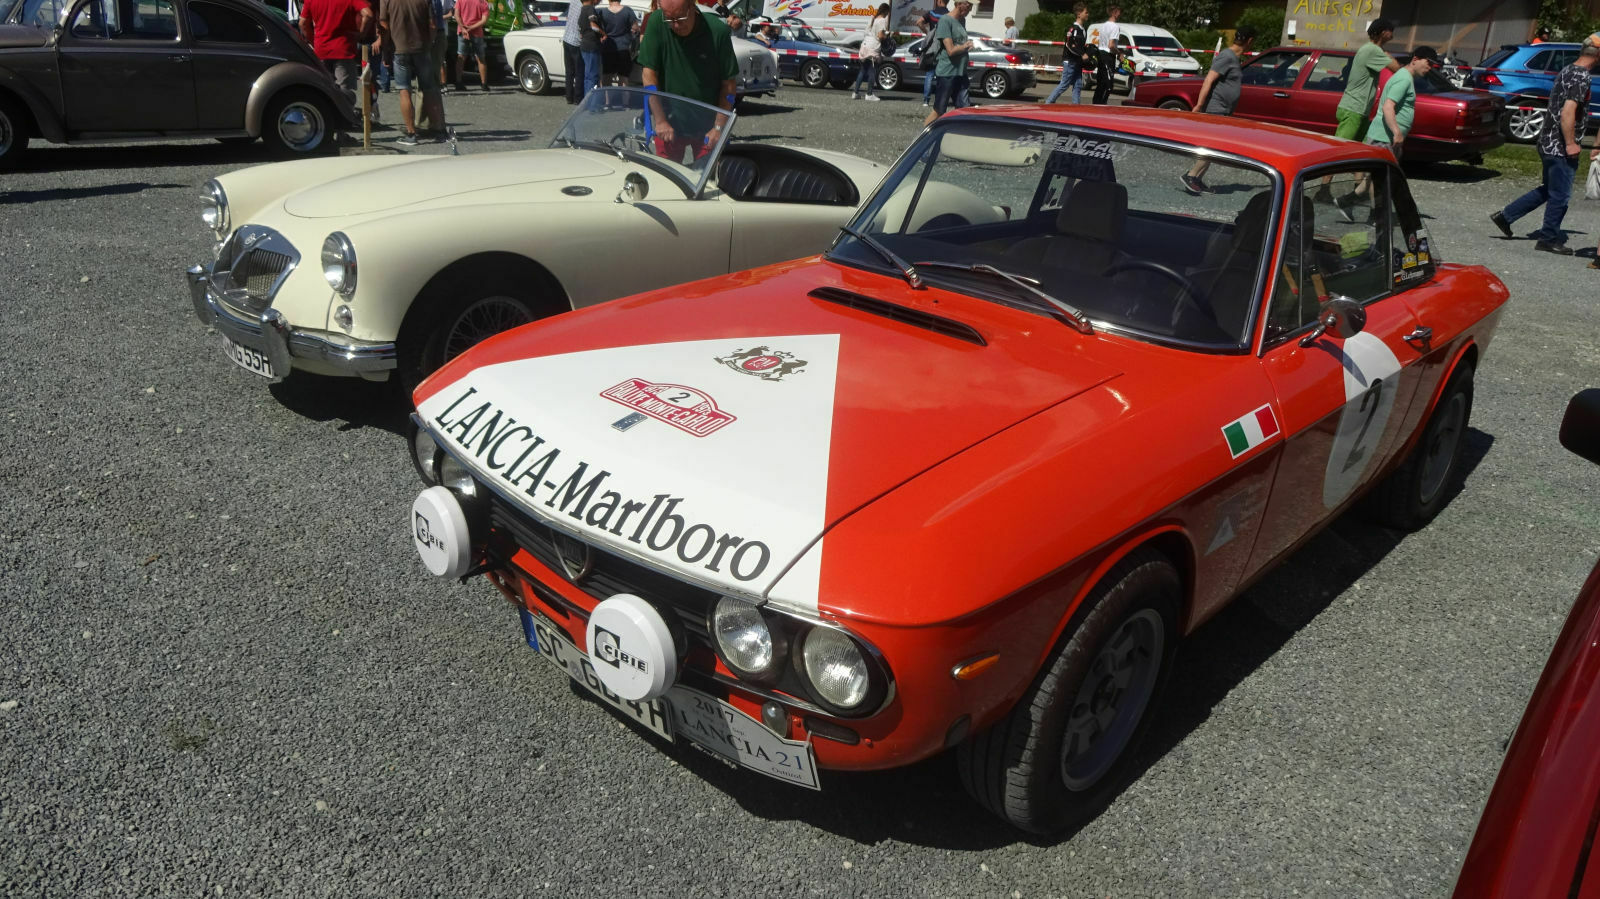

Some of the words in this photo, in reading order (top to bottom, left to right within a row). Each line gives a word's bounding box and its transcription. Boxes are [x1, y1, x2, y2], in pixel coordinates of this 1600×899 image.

[1305, 19, 1355, 32] macht
[244, 344, 273, 375] 55H
[608, 380, 651, 405] RALLYE
[667, 392, 691, 403] 2
[1341, 377, 1383, 474] 2
[435, 386, 771, 583] LANCIA-Marlboro
[535, 623, 568, 668] SC
[603, 643, 648, 673] CIBIE
[693, 696, 734, 724] 2017
[680, 709, 773, 763] LANCIA
